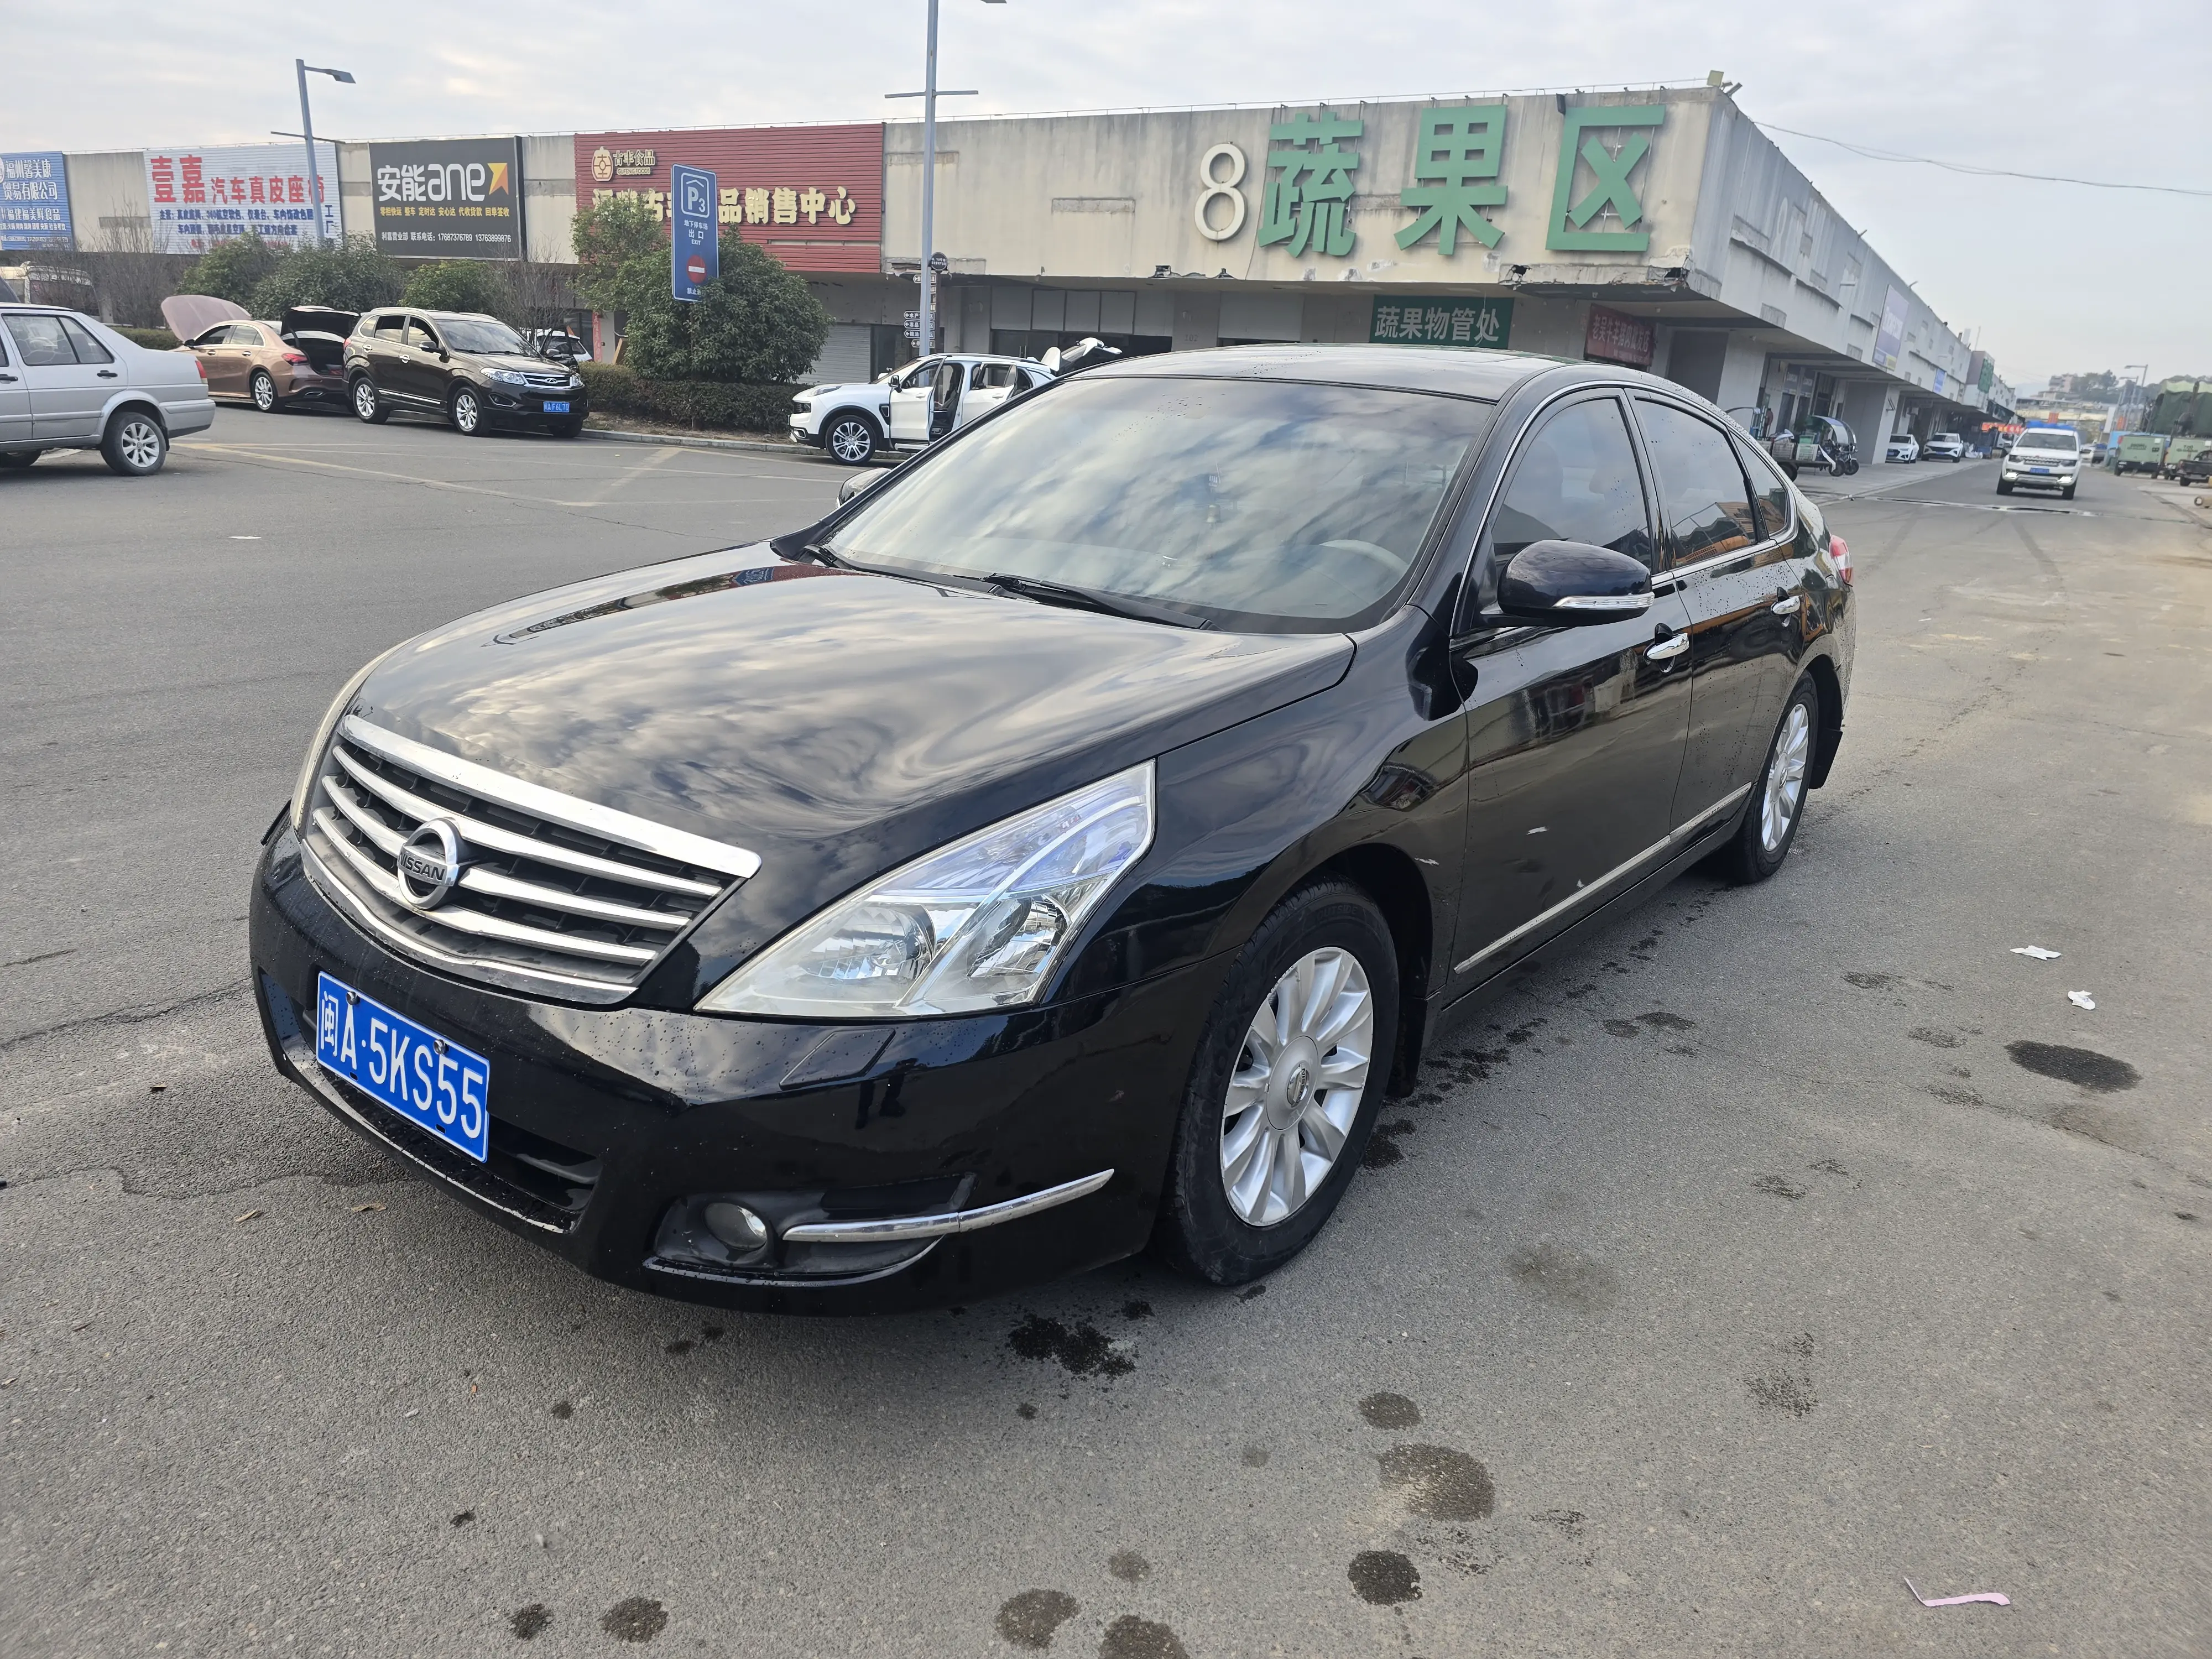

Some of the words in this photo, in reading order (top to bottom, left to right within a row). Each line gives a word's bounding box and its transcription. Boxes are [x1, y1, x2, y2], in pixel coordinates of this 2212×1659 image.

[613, 149, 656, 166] 古丰食品
[6, 159, 51, 179] 福州馨美康
[150, 154, 206, 204] 壹嘉
[1257, 104, 1666, 258] 蔬果区
[3, 181, 58, 200] 贸易有限公司
[1194, 142, 1248, 241] 8
[404, 206, 416, 216] 整车
[418, 206, 436, 216] 定时达
[438, 206, 456, 216] 安心达
[458, 207, 482, 217] 代收货款
[485, 207, 509, 217] 回单签收
[684, 220, 708, 231] 地下停车场
[688, 229, 703, 239] 出口
[438, 233, 473, 242] 17687376789
[1374, 305, 1500, 342] 蔬果物管处
[399, 853, 445, 881] NISSAN
